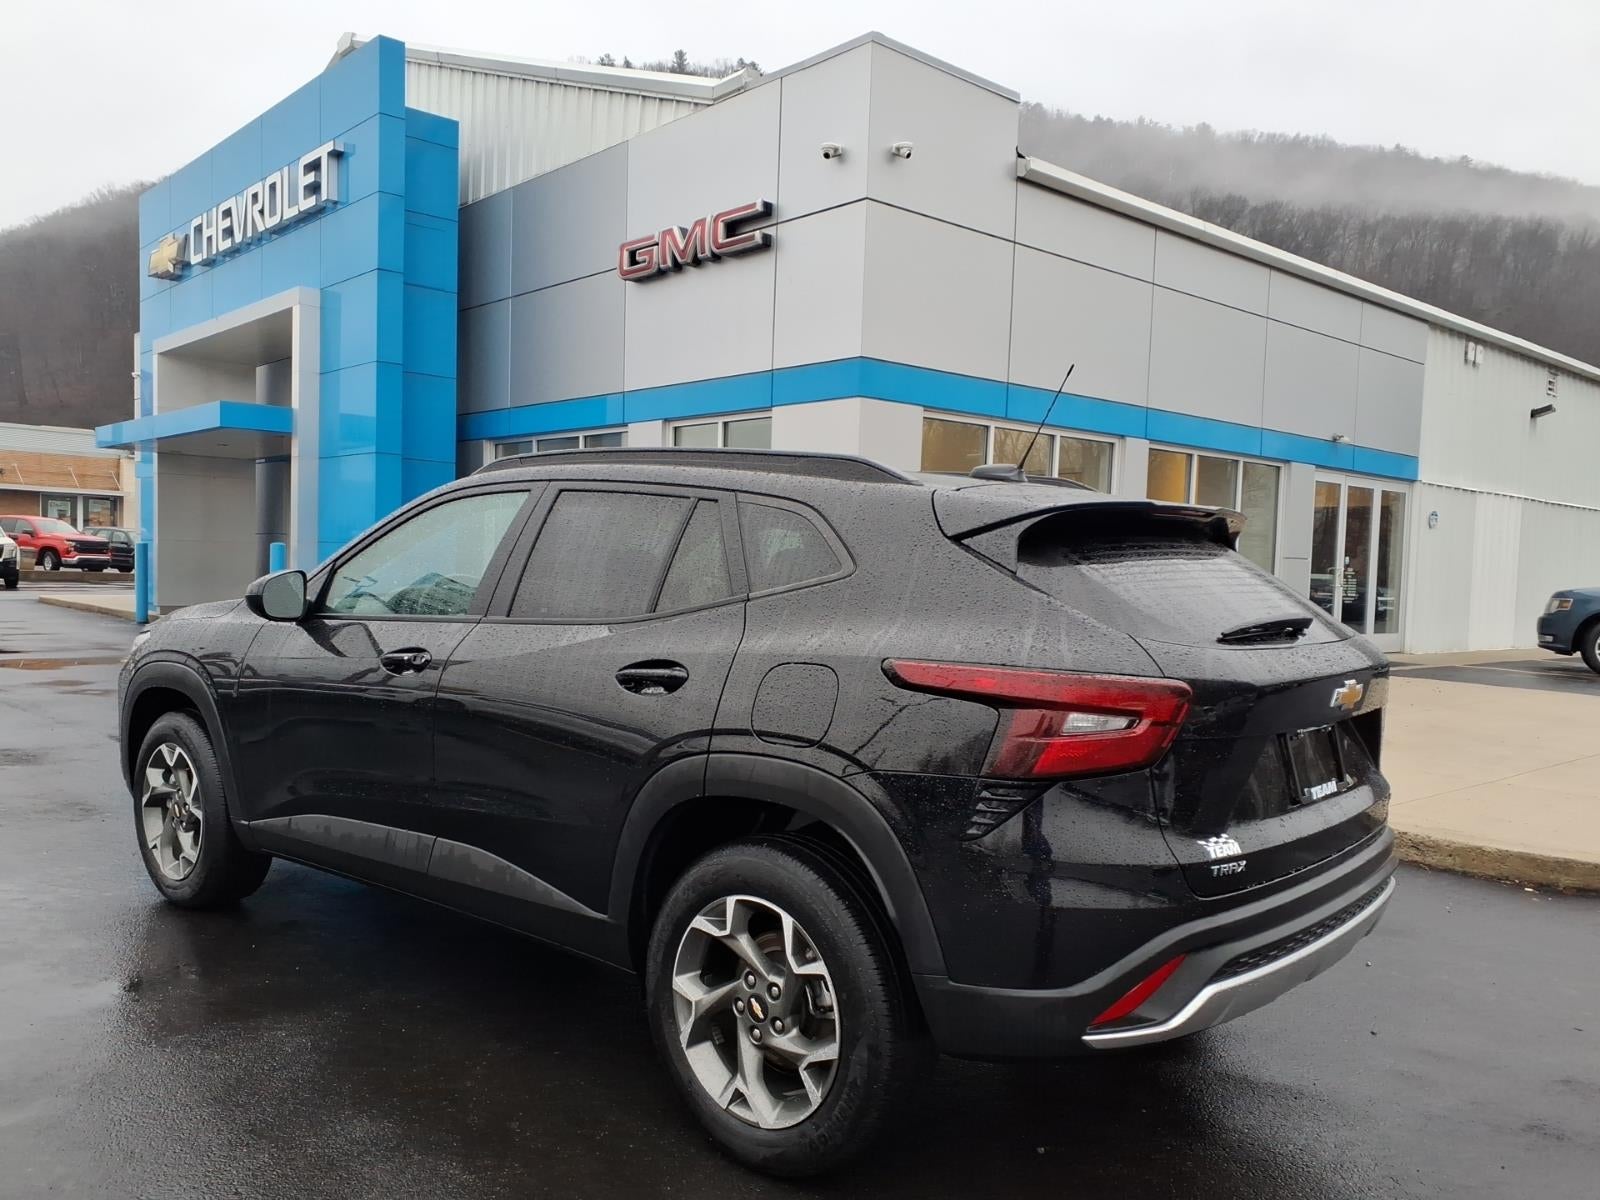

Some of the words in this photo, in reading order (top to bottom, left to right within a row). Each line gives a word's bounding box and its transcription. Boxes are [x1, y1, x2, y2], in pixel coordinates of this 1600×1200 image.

[190, 139, 341, 265] CHEVROLET
[617, 198, 772, 281] GMC
[1207, 841, 1242, 859] TEAM
[1210, 860, 1247, 877] TRAX
